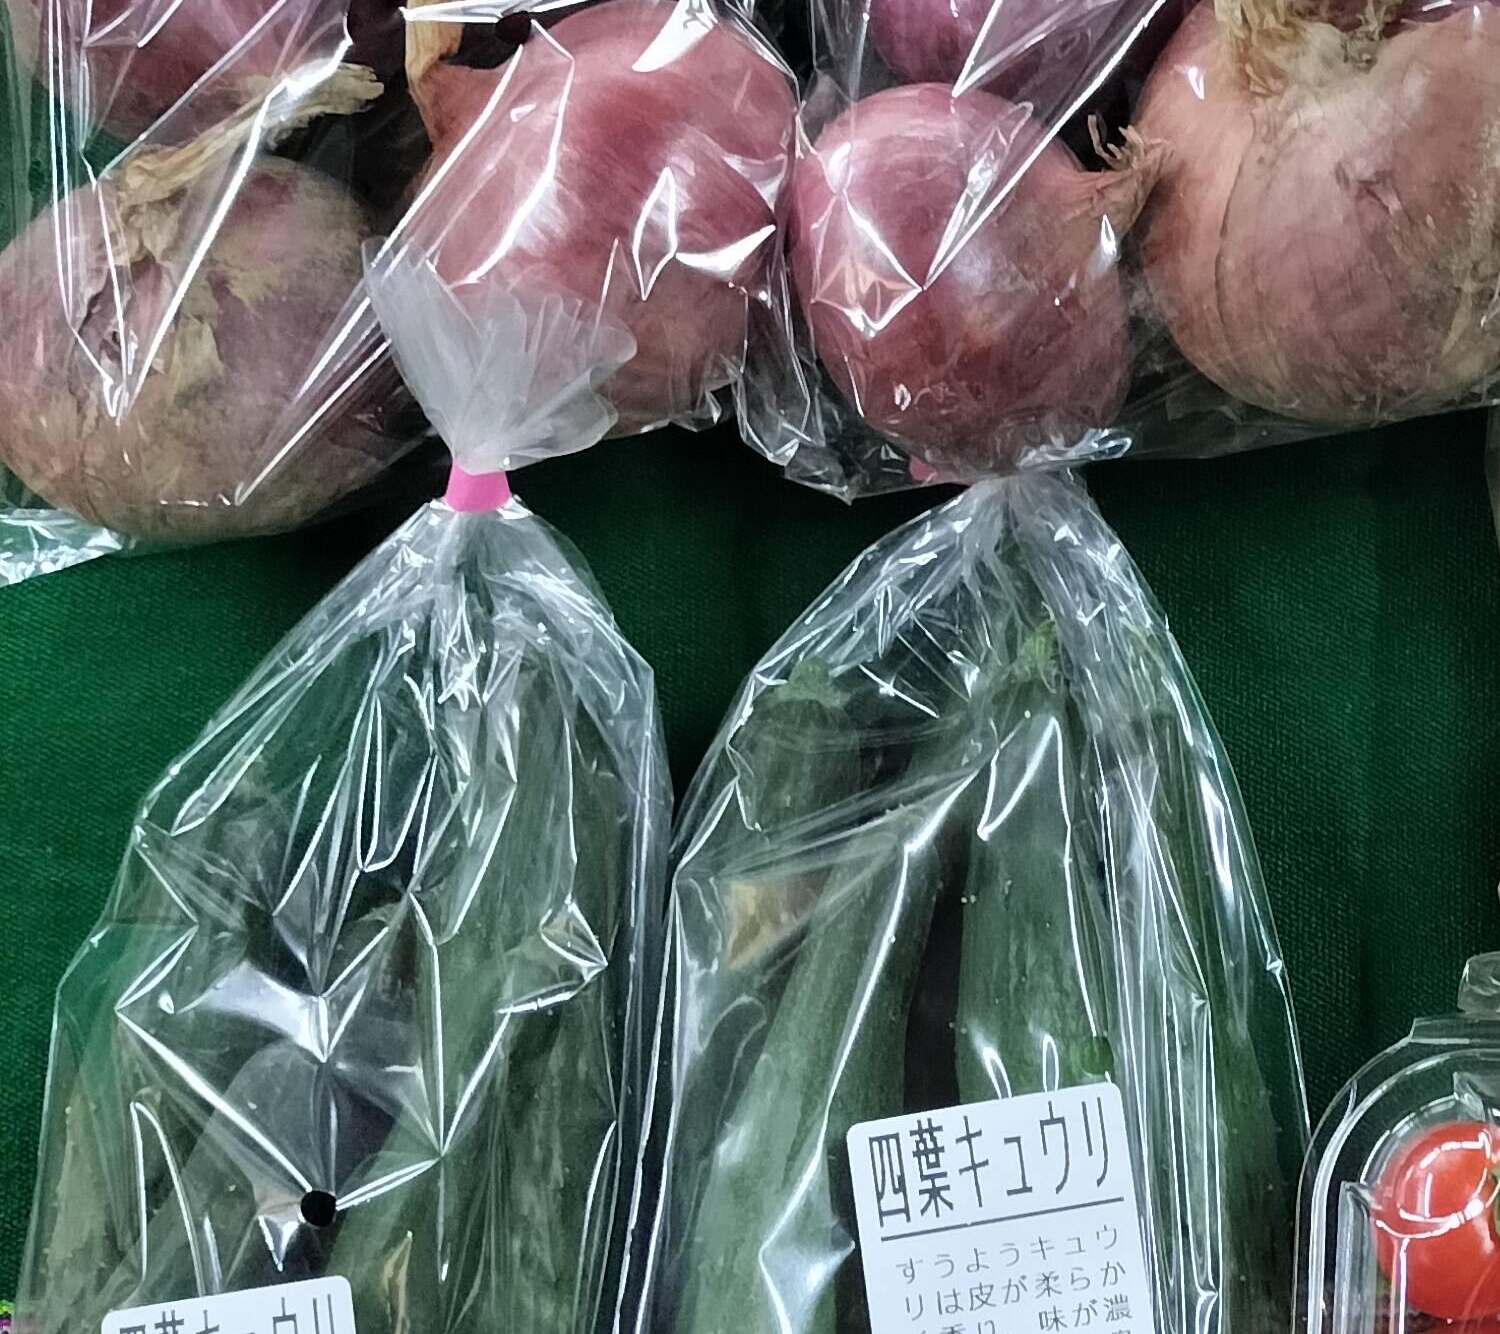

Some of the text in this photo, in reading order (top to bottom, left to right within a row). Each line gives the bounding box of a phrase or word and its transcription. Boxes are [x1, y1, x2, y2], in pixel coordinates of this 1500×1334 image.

[868, 1097, 1108, 1228] 四葉キュウリ
[896, 1224, 1117, 1284] すうようキュウ
[906, 1261, 1126, 1321] リは皮が柔らか
